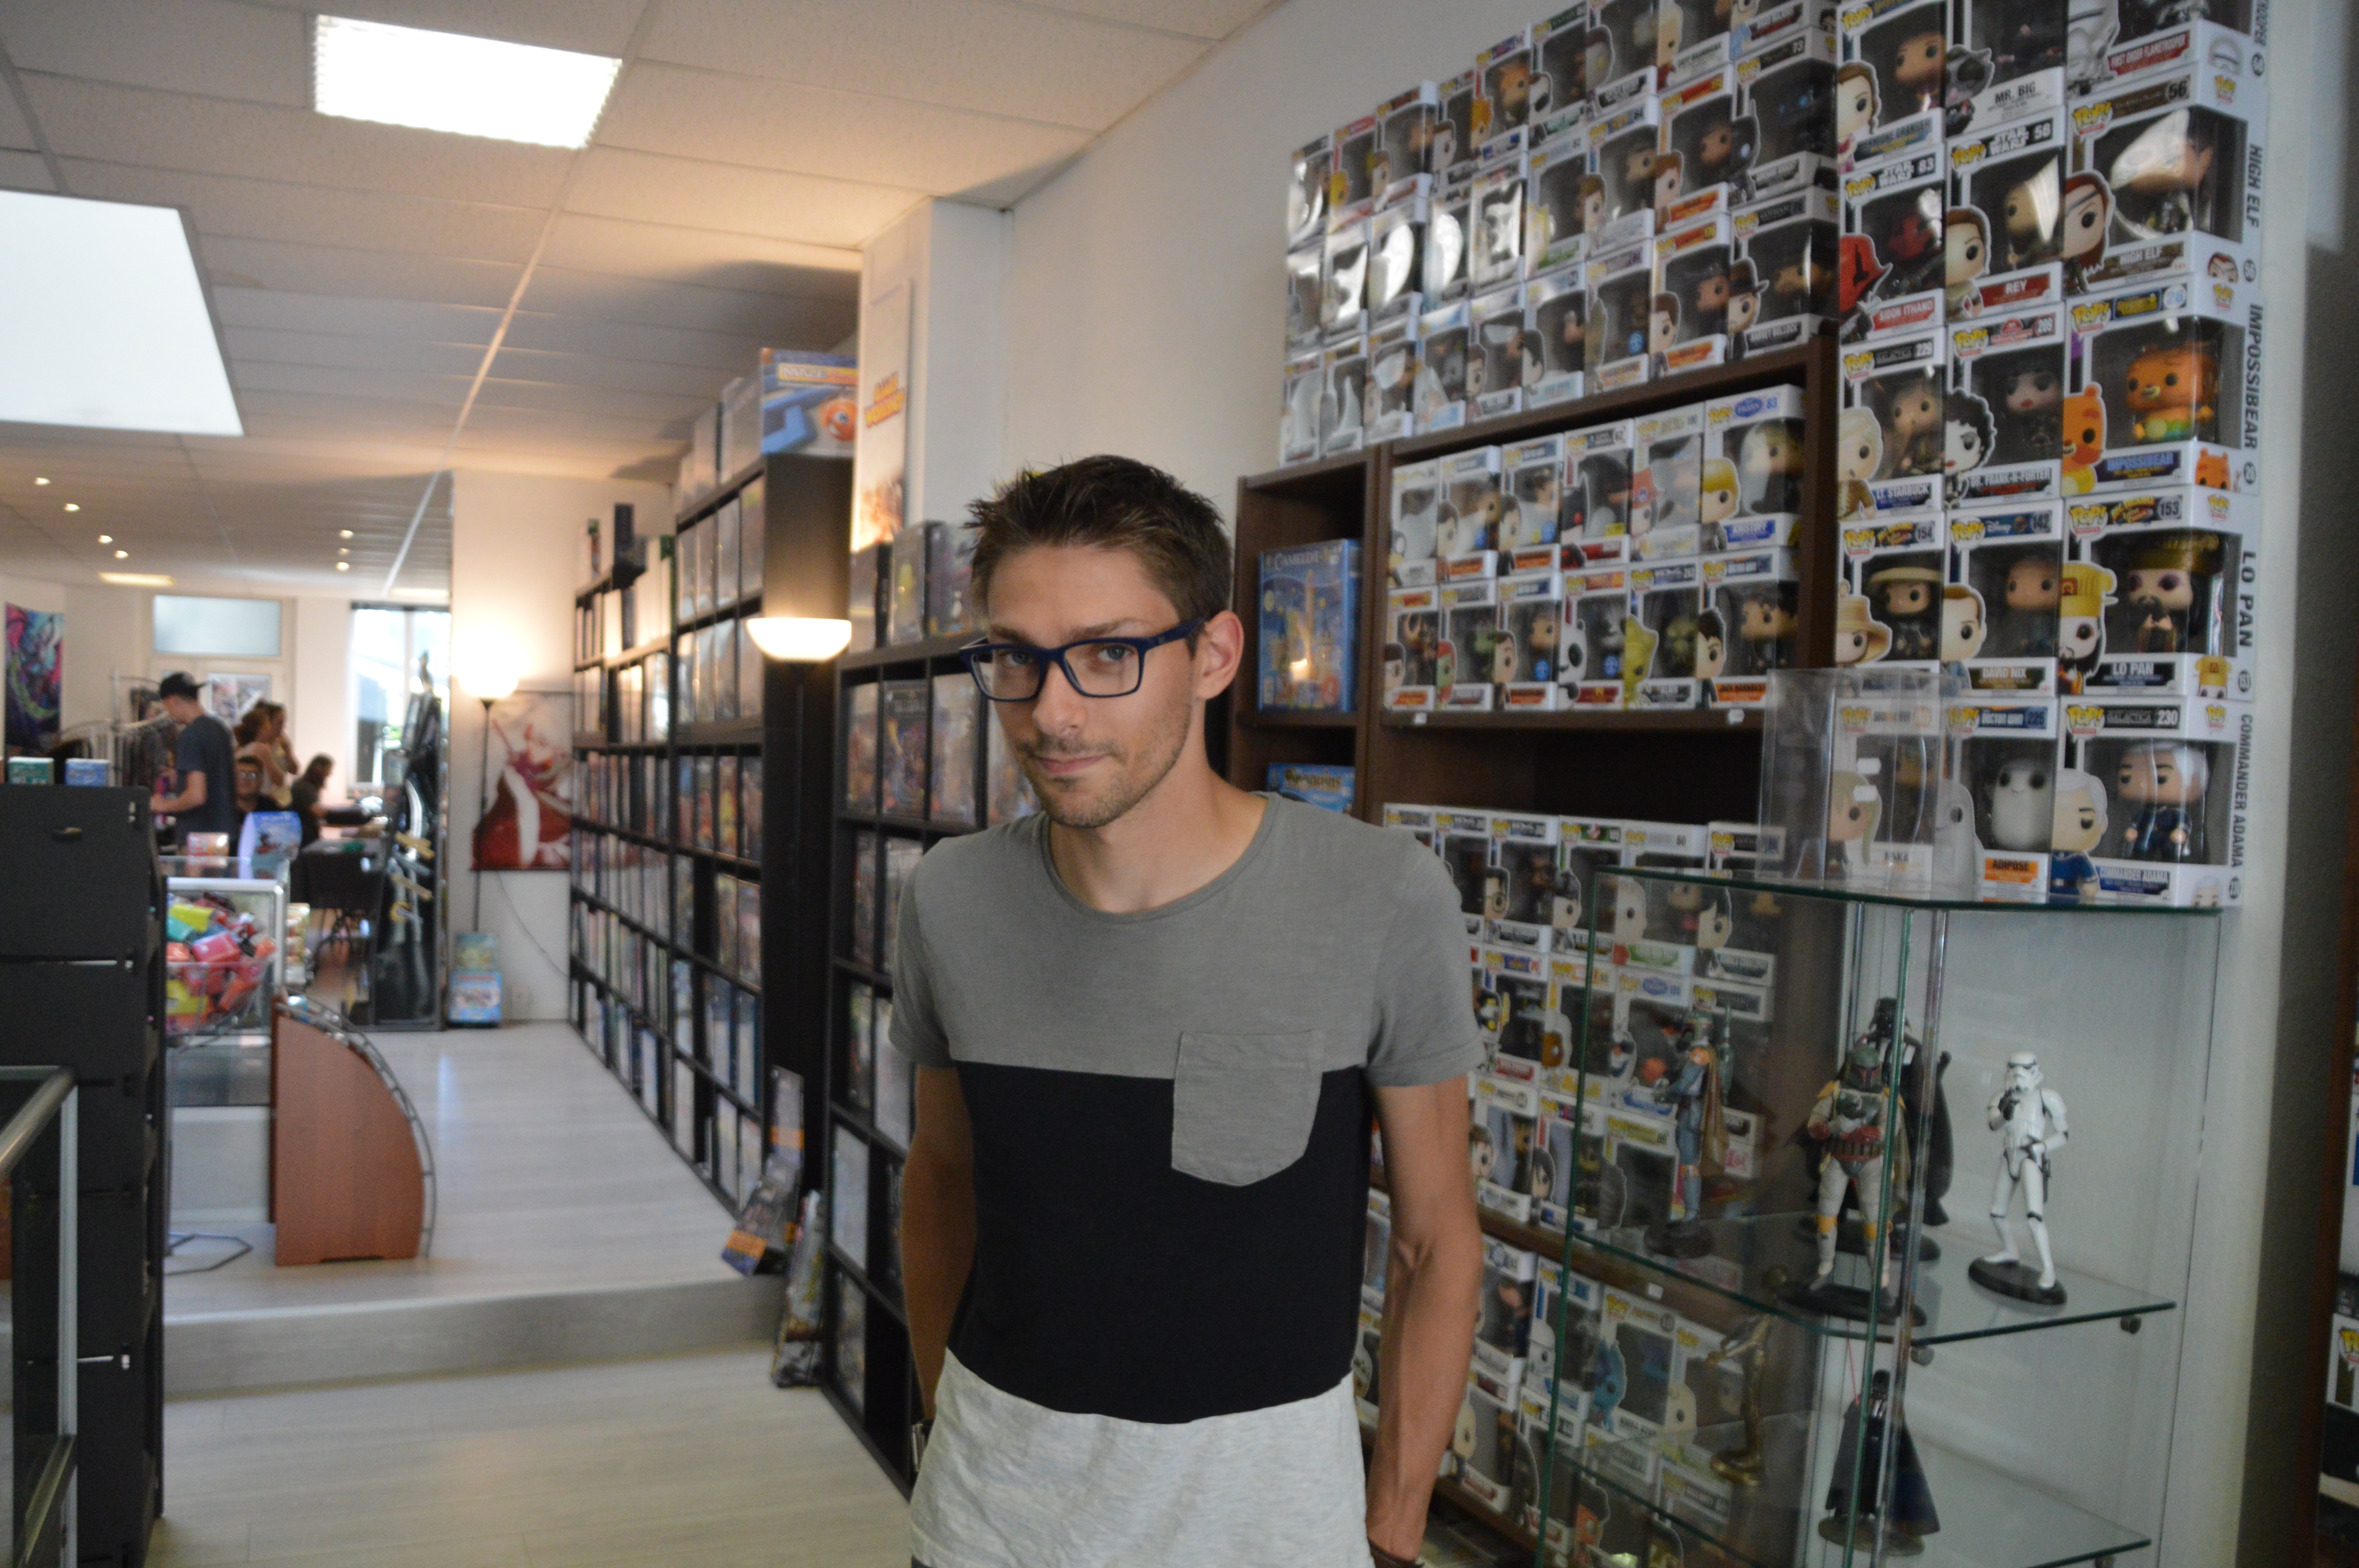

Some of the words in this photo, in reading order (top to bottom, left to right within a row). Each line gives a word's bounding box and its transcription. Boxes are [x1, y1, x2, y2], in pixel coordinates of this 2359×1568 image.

[1995, 89, 2015, 104] MR.
[2018, 81, 2036, 96] BIG
[2168, 80, 2187, 98] 56
[2073, 102, 2112, 126] POP!
[1995, 126, 2028, 143] STAR
[2035, 123, 2050, 138] 58
[1952, 143, 1986, 168] POP!
[1990, 138, 2027, 155] WARS
[1883, 161, 1914, 177] STAR
[1919, 158, 1934, 172] 83
[2248, 143, 2263, 190] HIGH
[1845, 176, 1876, 200] POP!
[1879, 172, 1912, 187] WARS
[2246, 193, 2261, 228] ELF
[2121, 250, 2143, 265] HIGH
[2146, 246, 2163, 260] ELF
[2006, 279, 2028, 294] REY
[1904, 300, 1933, 315] ITHANO
[2072, 301, 2110, 325] POP!
[1954, 328, 1988, 350] POP!
[1844, 352, 1875, 372] POP!
[2245, 303, 2263, 449] IMPOSSIBEAR
[1888, 484, 1929, 499] STARBUCK
[2070, 506, 2107, 526] POP!
[2160, 502, 2179, 516] 153
[1844, 530, 1875, 548] POP!
[1951, 522, 1985, 543] POP!
[2241, 550, 2257, 584] LO
[2238, 594, 2255, 648] PAN
[1983, 667, 2008, 678] DAVID
[2011, 667, 2026, 679] NIX
[2113, 662, 2127, 675] LO
[2130, 662, 2154, 675] PAN
[2066, 706, 2105, 726] POP!
[2157, 710, 2177, 725] 230
[2234, 714, 2254, 811] COMMANDER
[2231, 814, 2247, 868] ADAMA
[2099, 866, 2142, 880] COMMANDER
[2143, 871, 2168, 883] ADAMA
